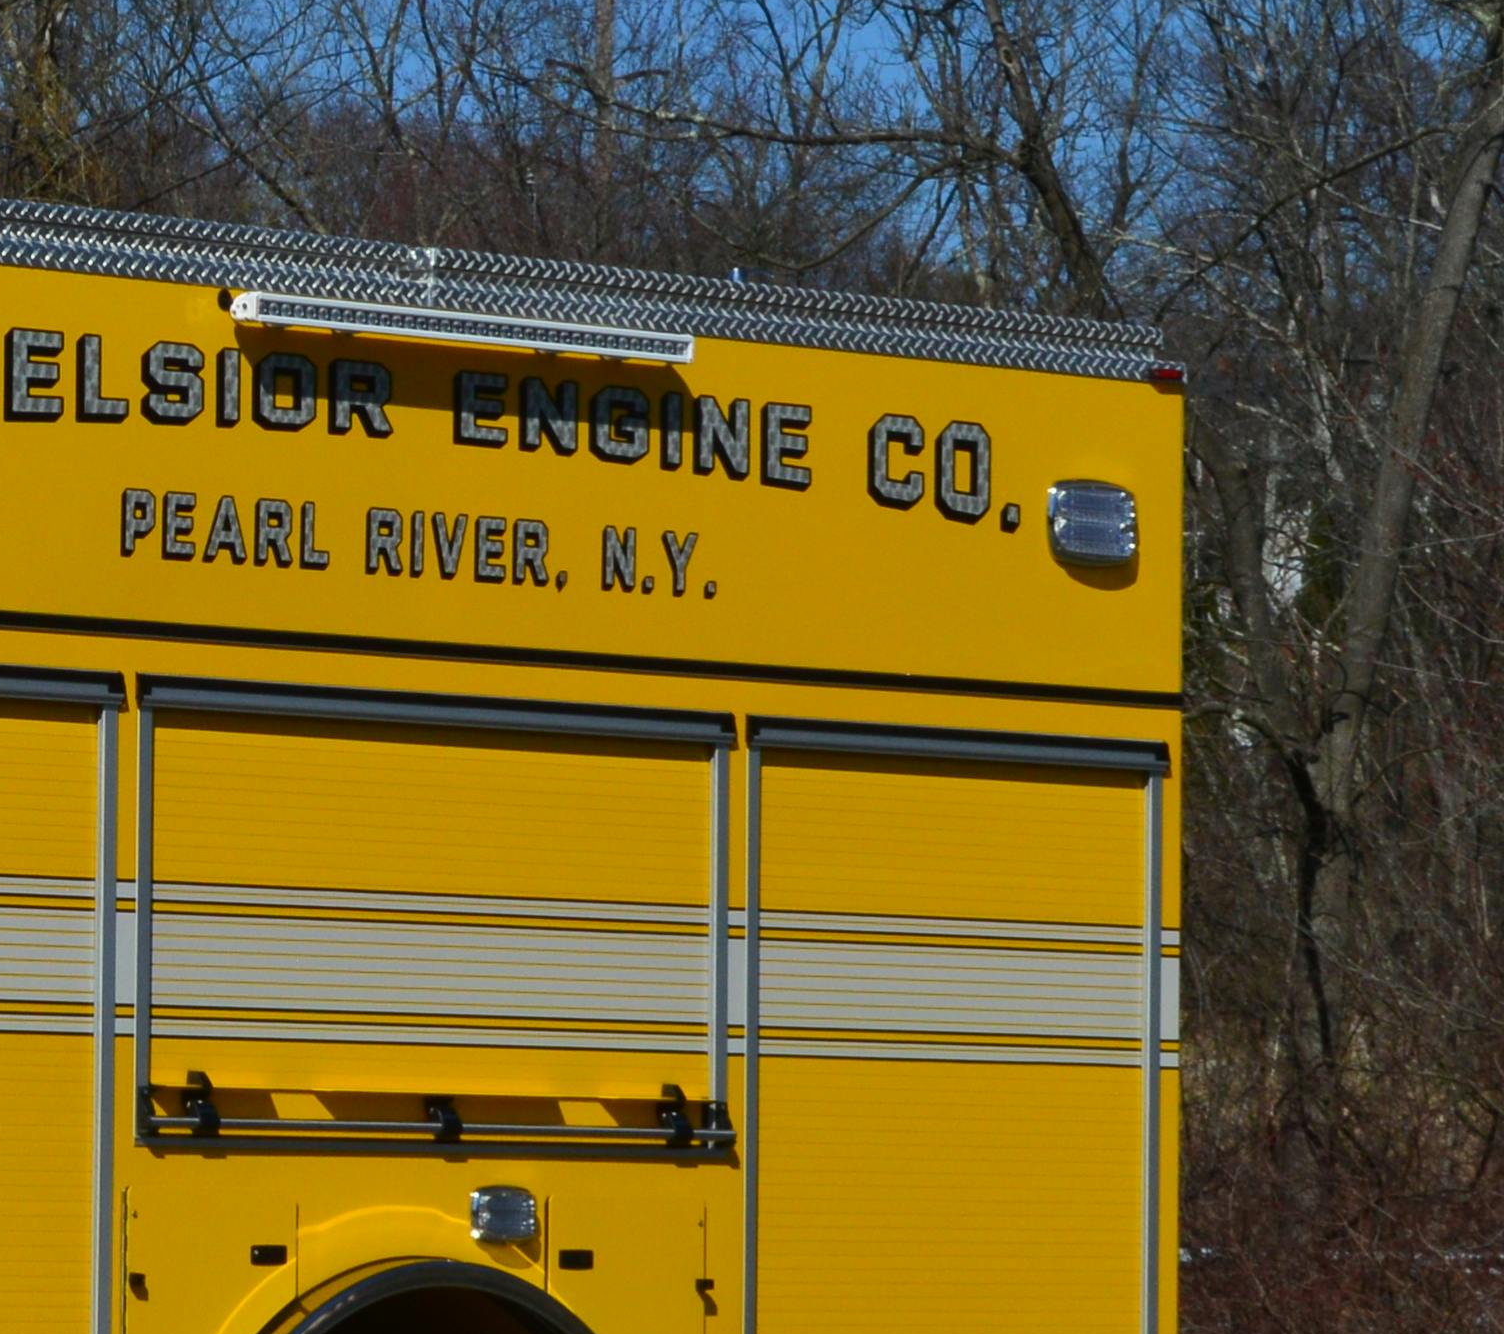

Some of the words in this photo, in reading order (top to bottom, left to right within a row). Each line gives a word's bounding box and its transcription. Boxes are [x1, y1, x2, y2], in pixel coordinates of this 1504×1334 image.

[453, 370, 813, 490] ENGINE
[867, 412, 1021, 534] CO.
[120, 487, 330, 571] PEARL
[365, 506, 569, 593] RIVER,
[601, 525, 718, 601] N.Y.
